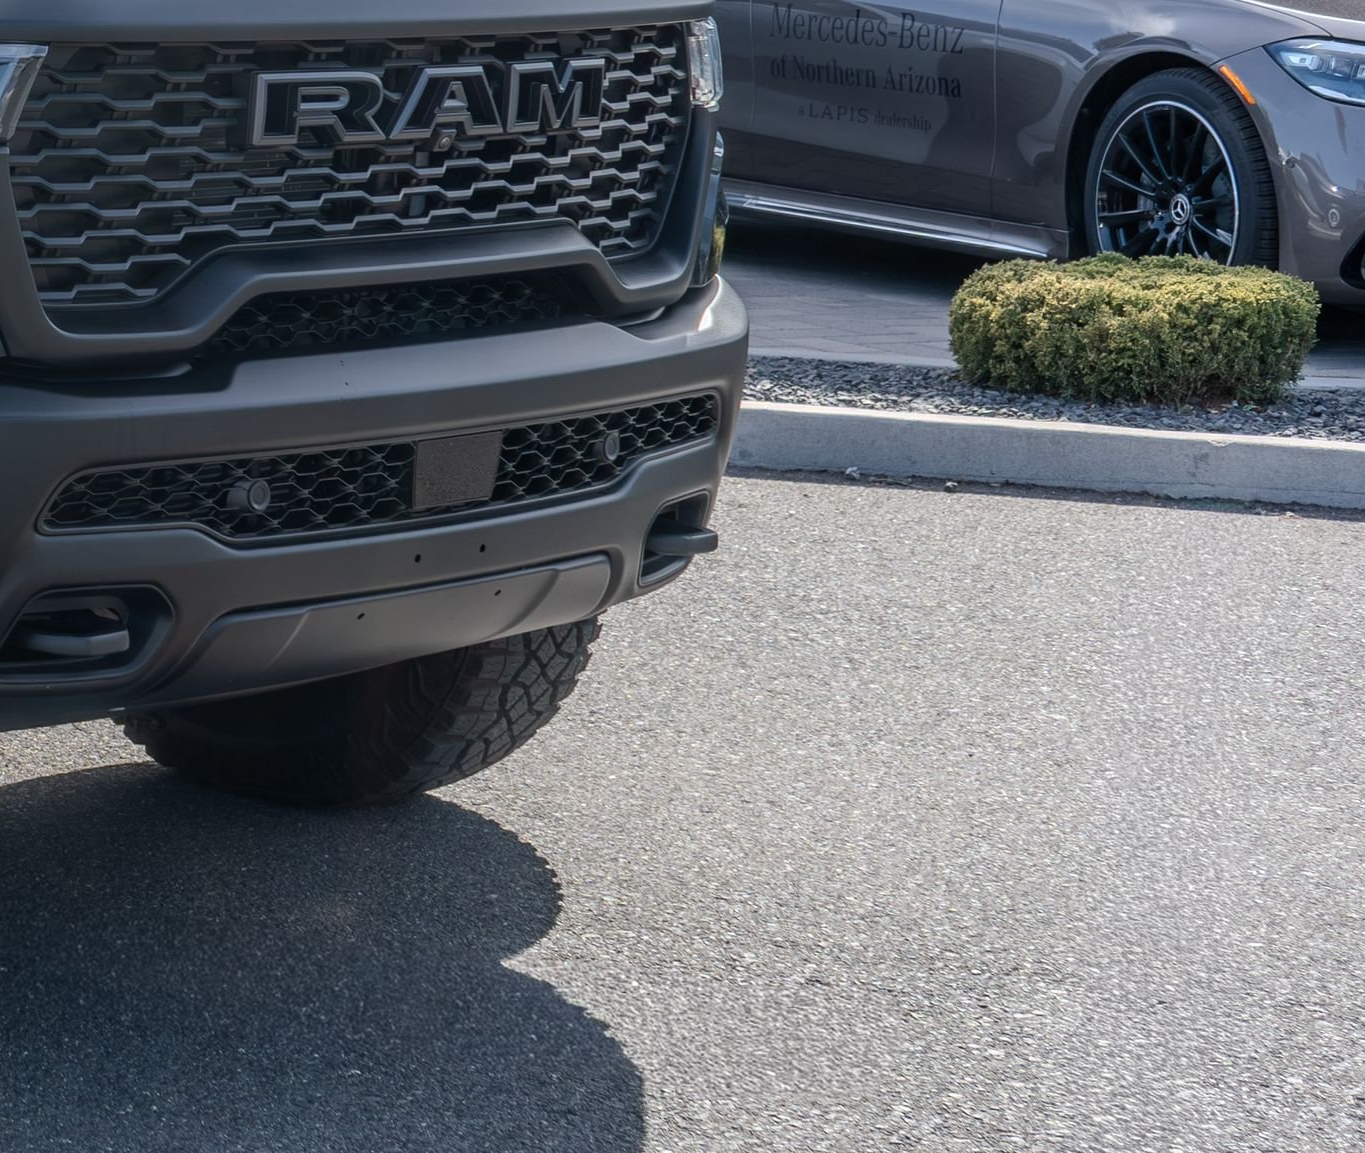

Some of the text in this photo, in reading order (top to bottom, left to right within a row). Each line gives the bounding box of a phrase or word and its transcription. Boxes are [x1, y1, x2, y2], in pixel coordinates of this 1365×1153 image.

[770, 1, 966, 55] Mercedes-Benz
[770, 54, 963, 98] of Northern Arizona
[251, 57, 606, 146] RAM
[808, 102, 869, 124] LAPIS
[874, 109, 933, 135] dealership
